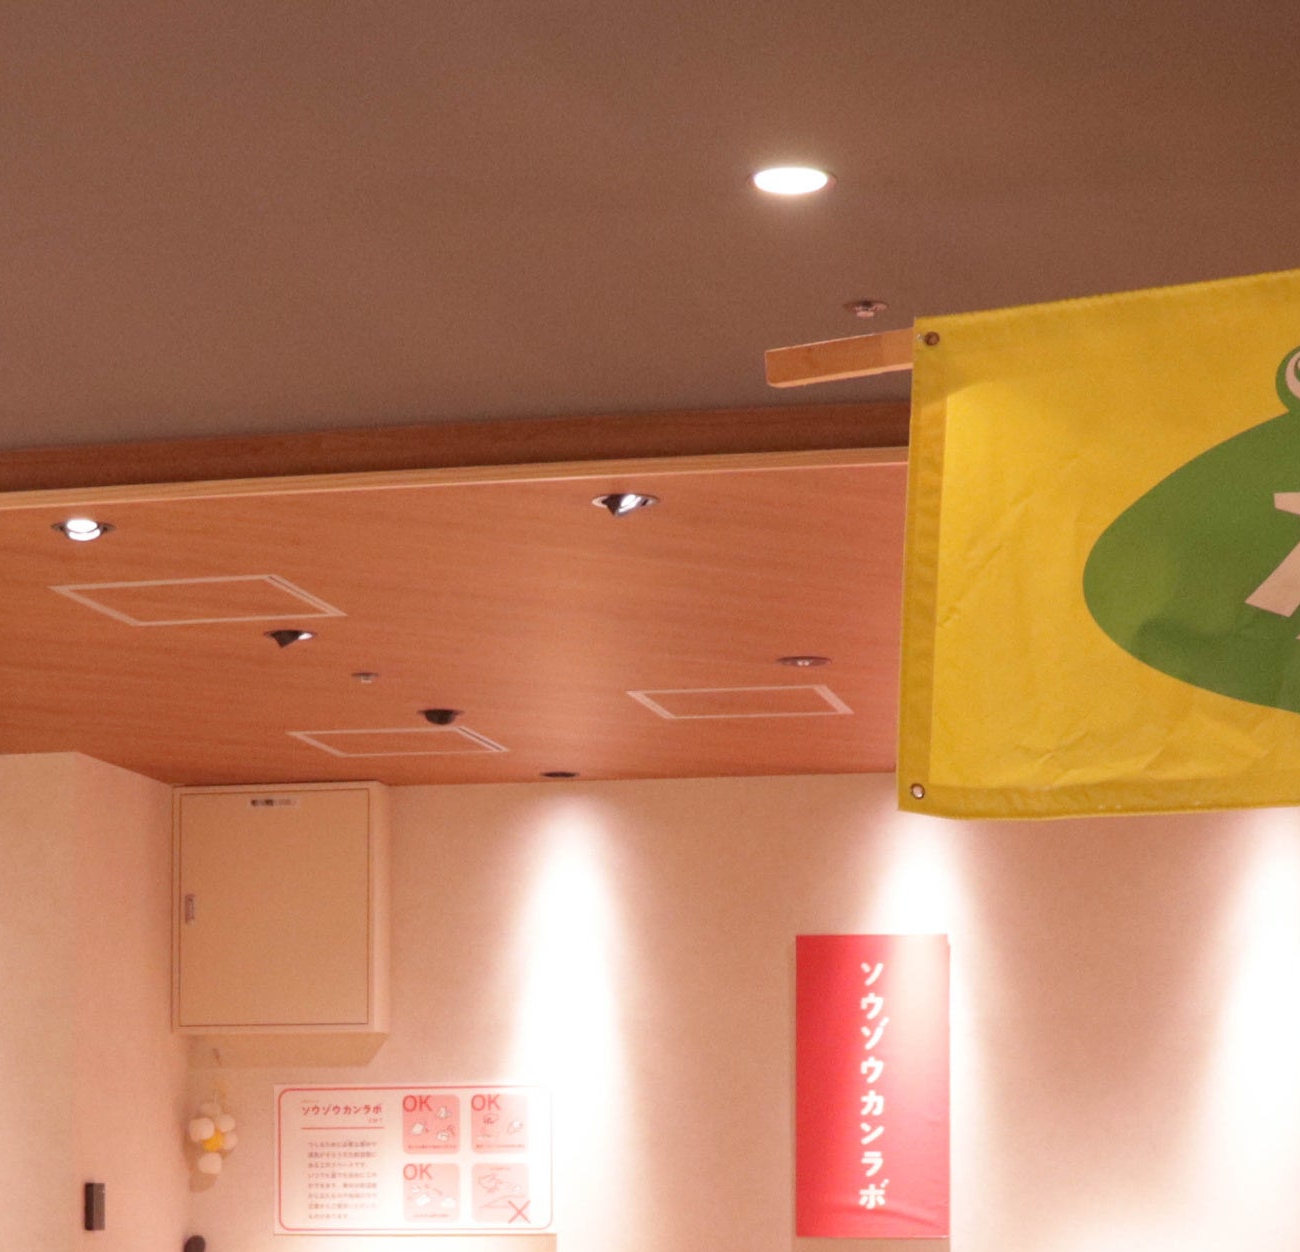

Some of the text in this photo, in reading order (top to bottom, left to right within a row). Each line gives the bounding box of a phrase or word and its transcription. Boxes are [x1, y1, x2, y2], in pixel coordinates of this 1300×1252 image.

[858, 962, 890, 1210] ソウゾウカンラボ
[302, 1104, 382, 1115] ソウゾウカンラボ
[402, 1095, 433, 1112] OK
[471, 1094, 501, 1111] OK
[402, 1164, 433, 1180] OK
